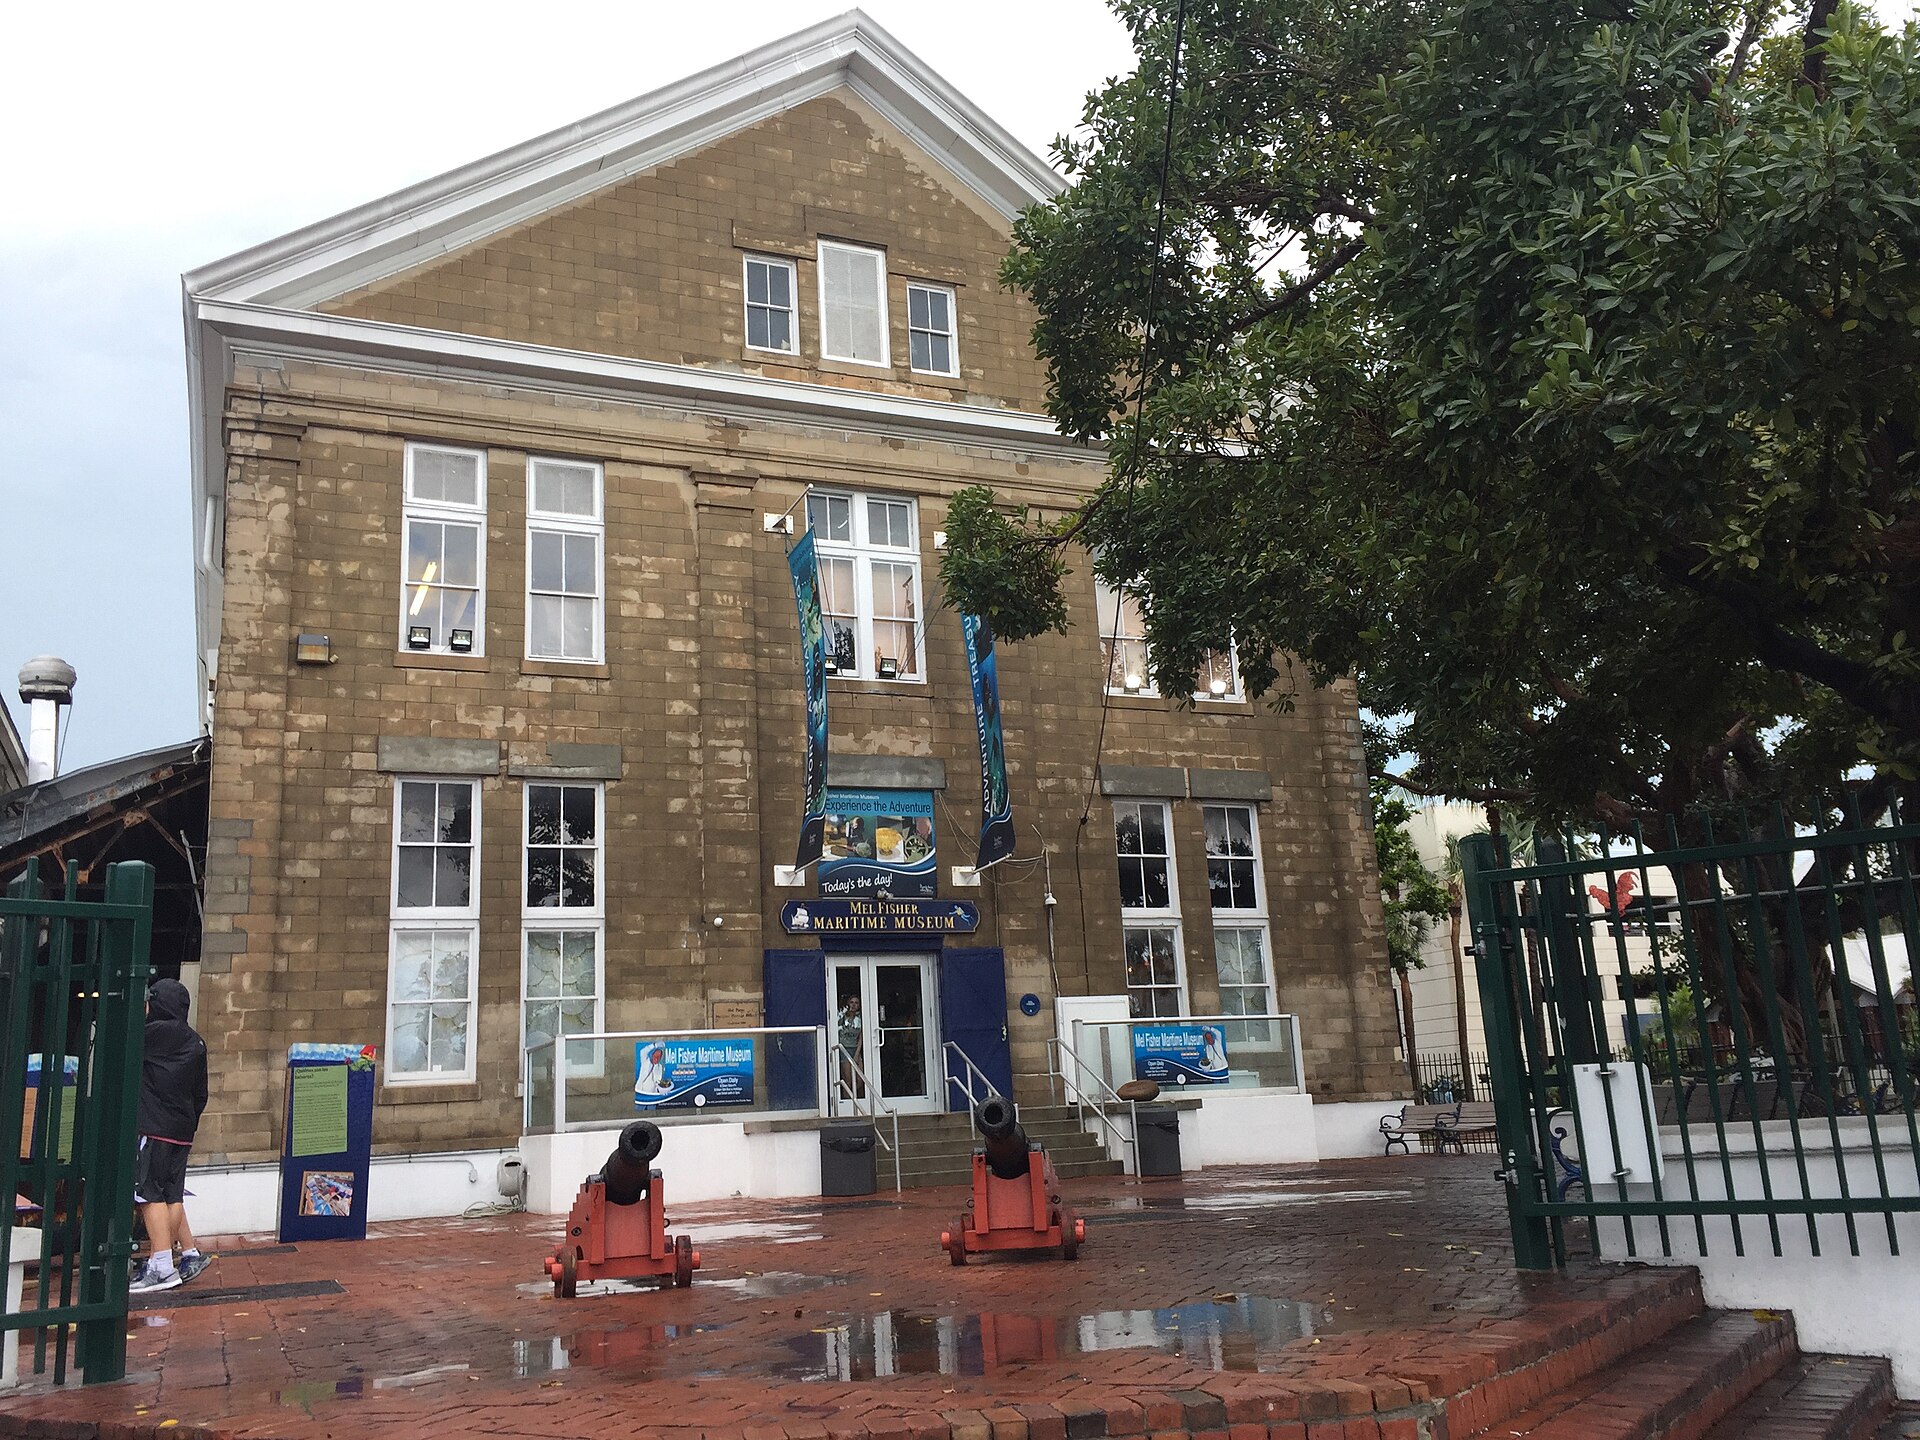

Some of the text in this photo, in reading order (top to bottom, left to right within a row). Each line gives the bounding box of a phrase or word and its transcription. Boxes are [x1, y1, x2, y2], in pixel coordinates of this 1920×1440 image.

[964, 615, 990, 813] ADVENTURE TREASU
[804, 734, 814, 816] HISTORY
[826, 799, 931, 813] Experience the Adventure
[822, 873, 893, 893] Today's the day!
[850, 902, 876, 915] MEL
[814, 916, 955, 930] MARITIME MUSEUM
[1135, 1032, 1204, 1047] Mel Fisher Maritime Museum
[665, 1045, 752, 1064] Mel Fisher Maritime Museum
